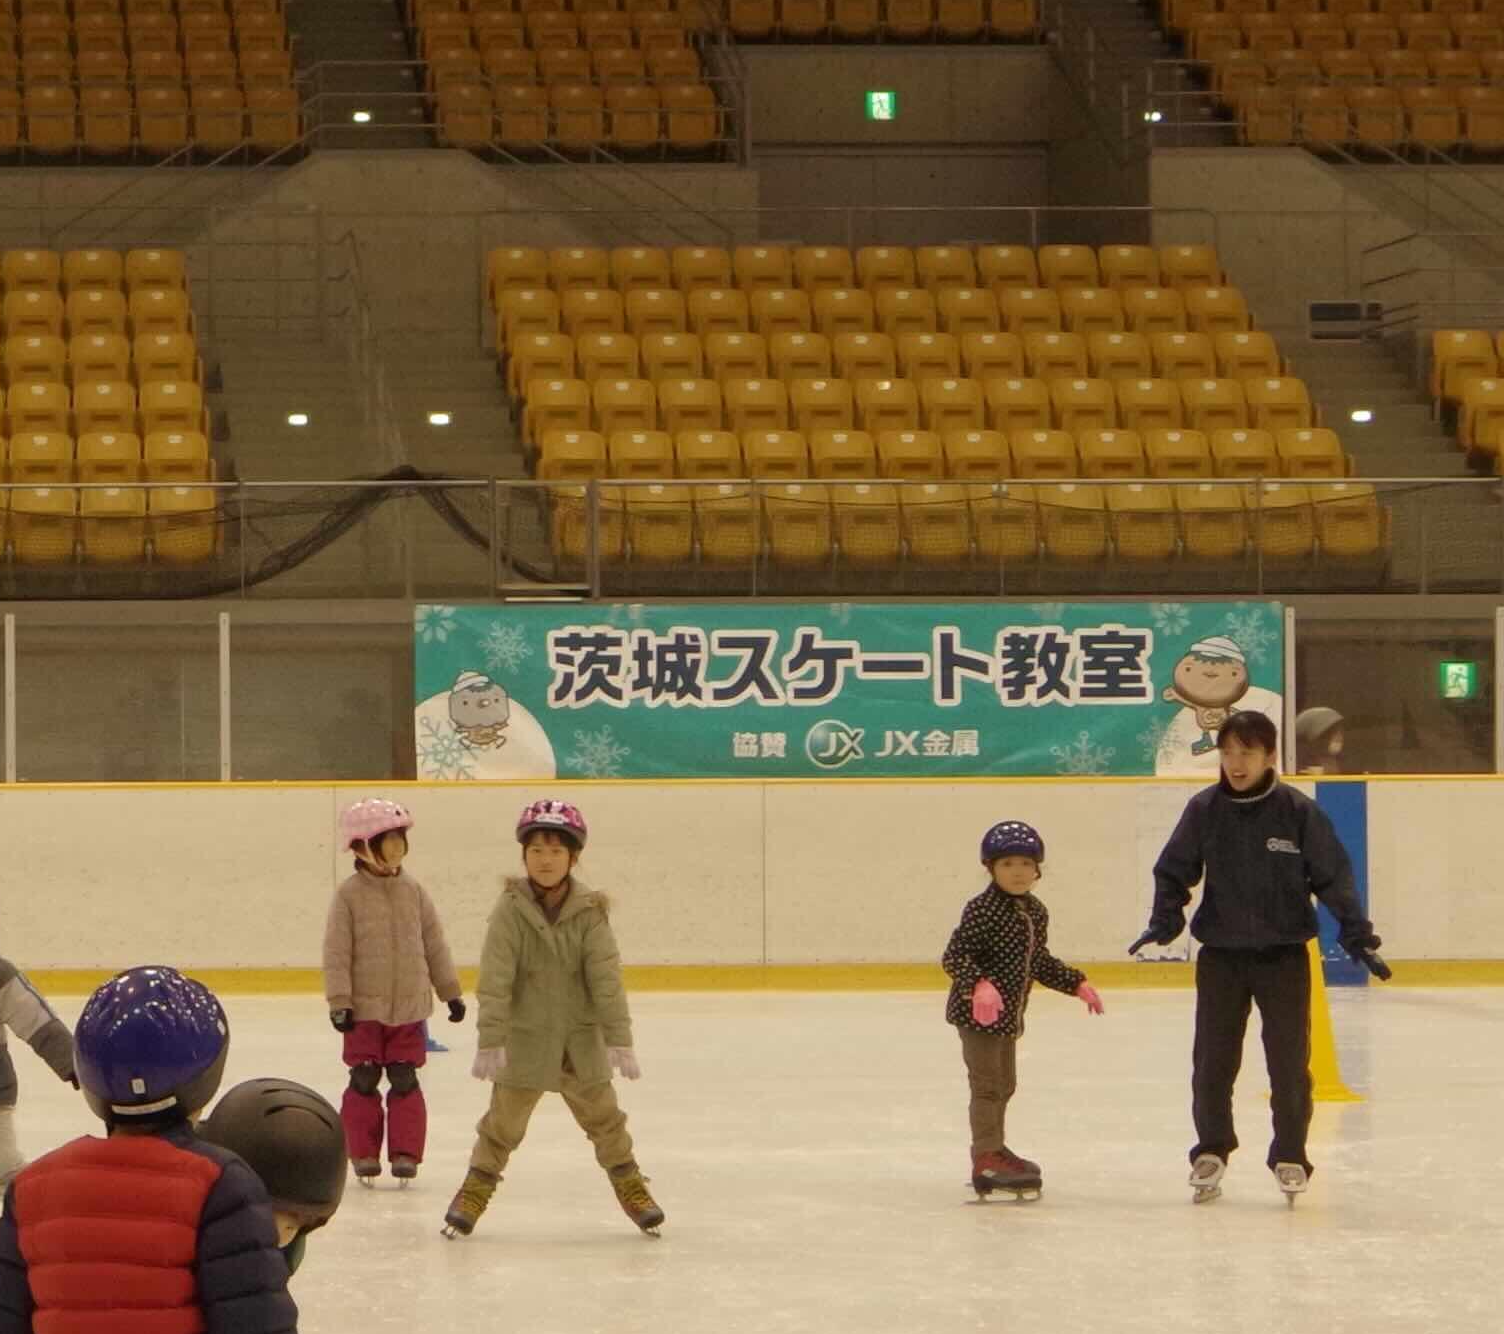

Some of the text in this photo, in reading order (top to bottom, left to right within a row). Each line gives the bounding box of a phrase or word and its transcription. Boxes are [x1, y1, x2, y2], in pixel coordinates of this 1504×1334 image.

[550, 628, 1150, 705] 茨城スケート教室
[733, 731, 787, 758] 協賛
[874, 729, 980, 757] JX金属
